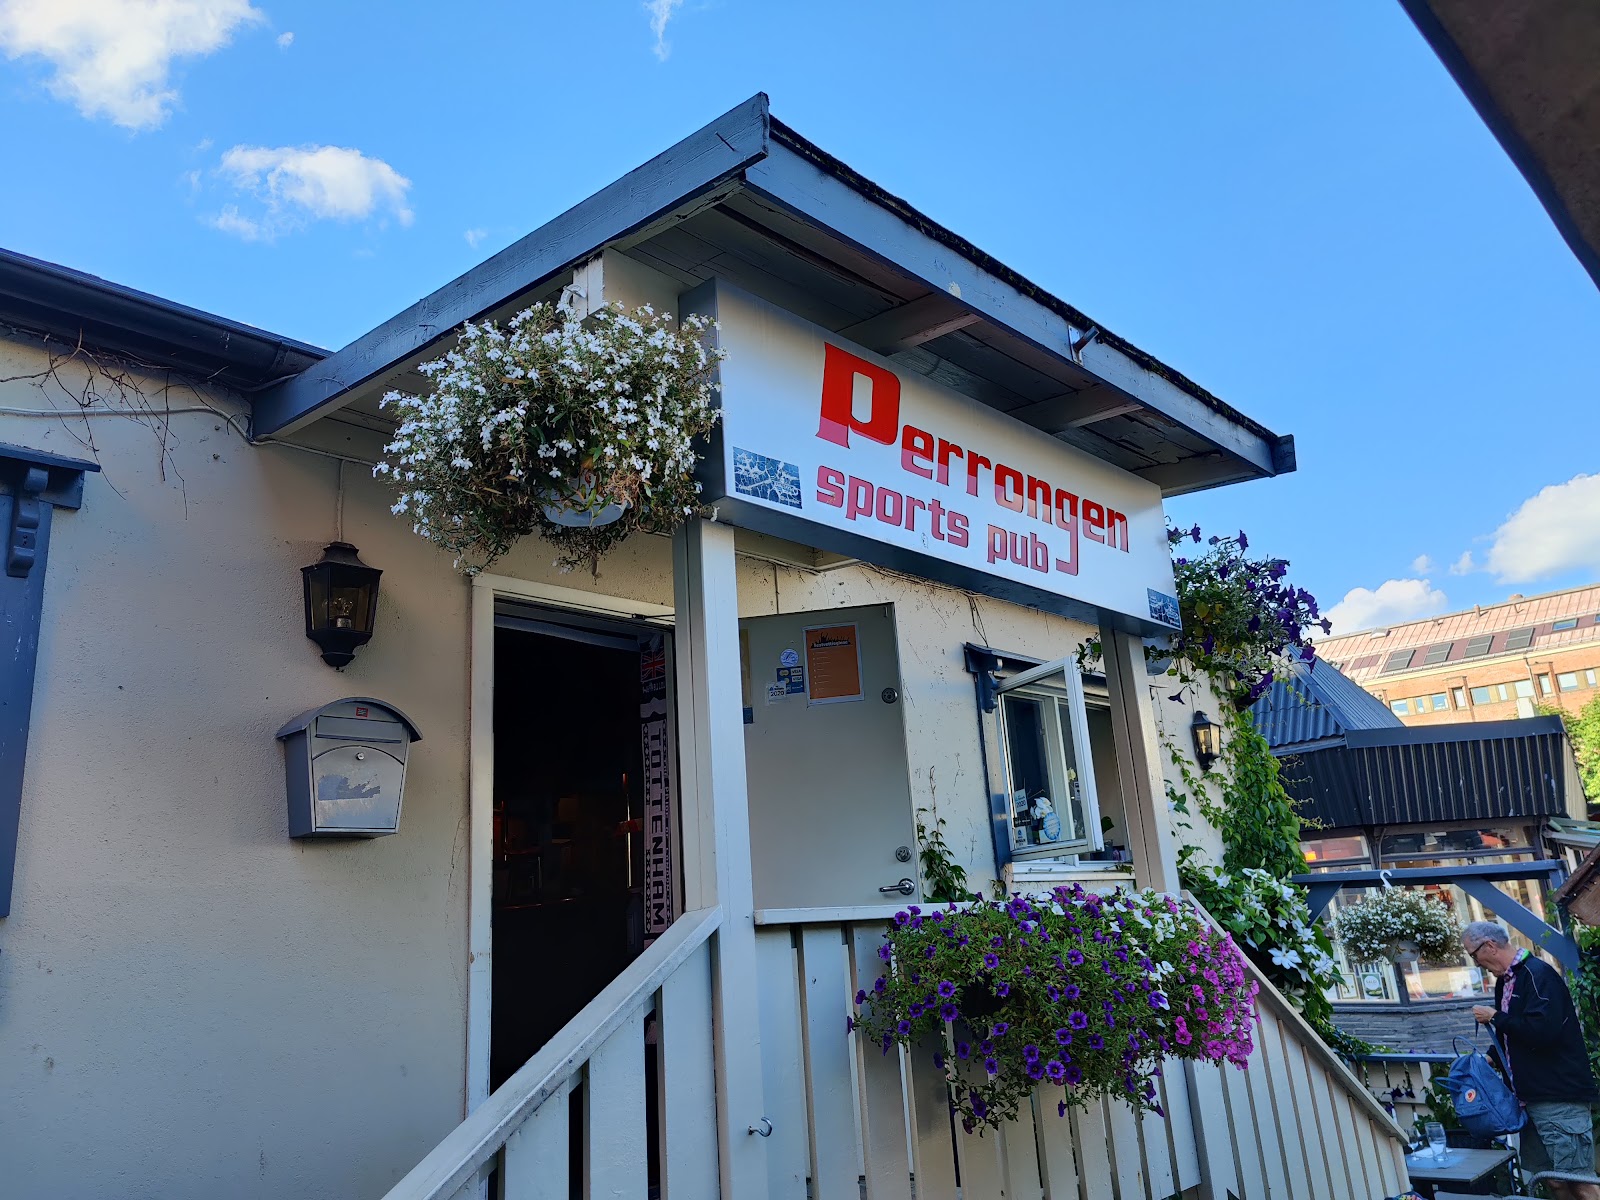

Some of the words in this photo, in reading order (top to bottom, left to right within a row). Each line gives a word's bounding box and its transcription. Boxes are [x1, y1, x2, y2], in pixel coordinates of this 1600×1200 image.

[815, 341, 1129, 576] Perrongen
[816, 465, 970, 549] sports
[987, 523, 1049, 574] pub
[651, 728, 665, 926] TOTTENHAM
